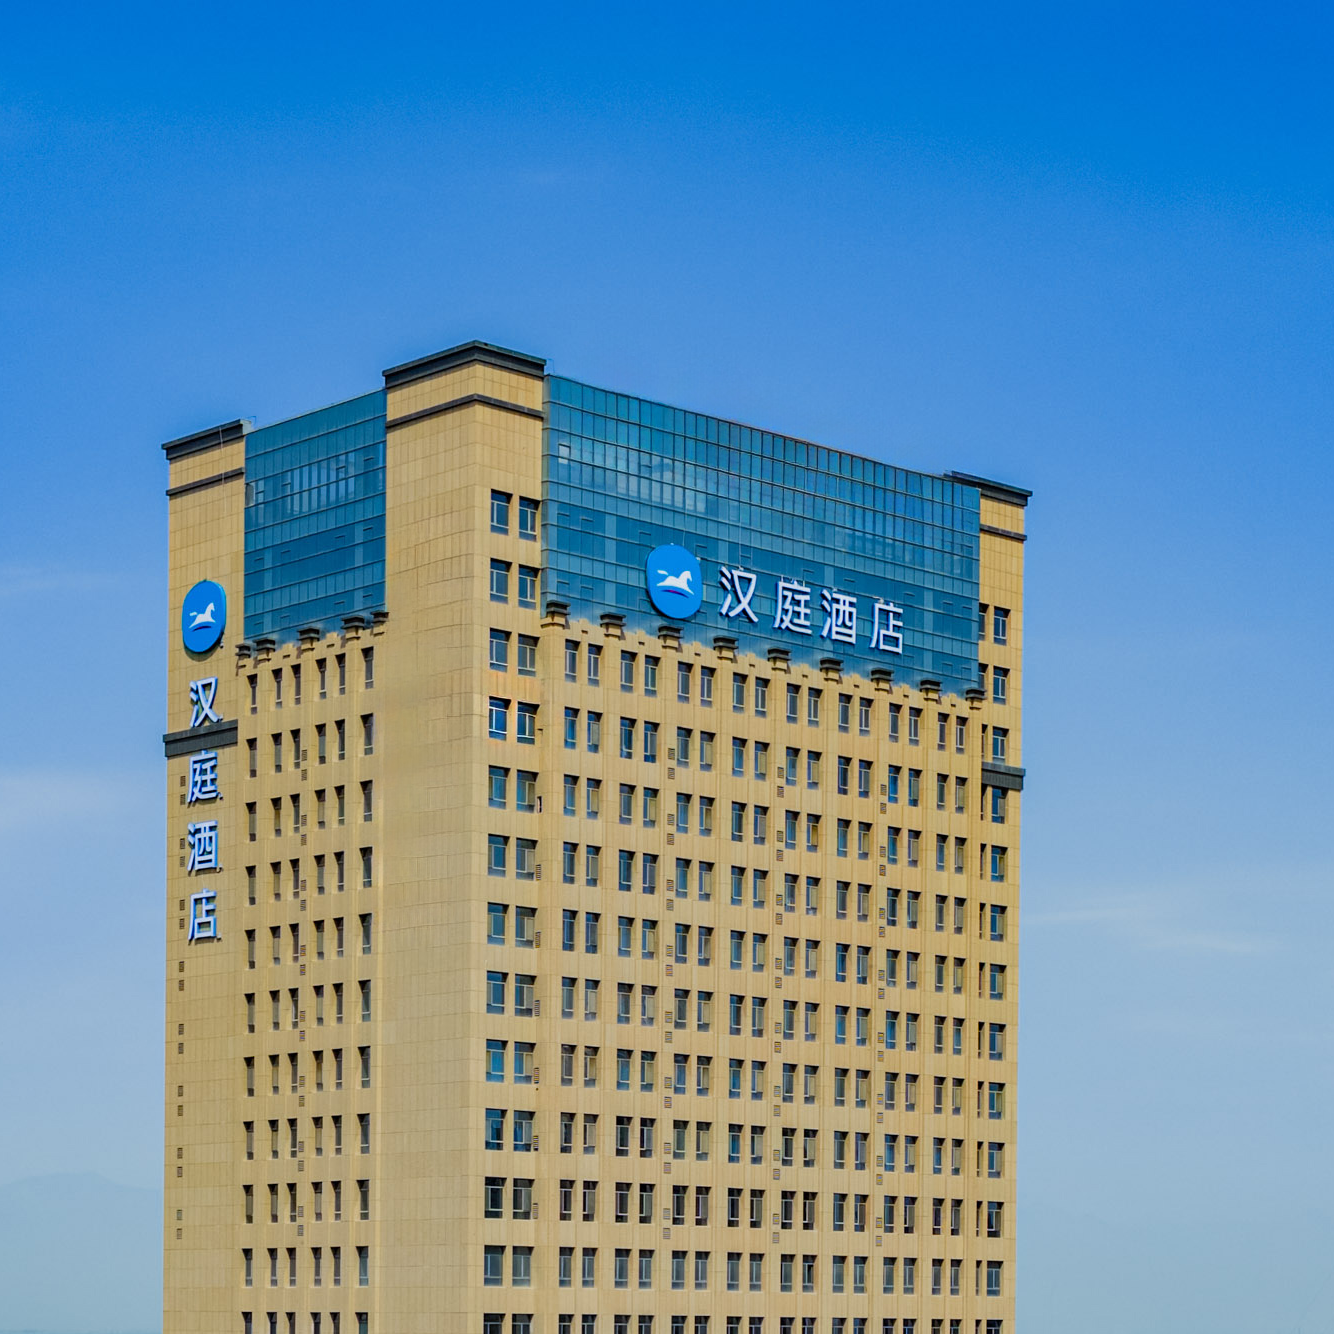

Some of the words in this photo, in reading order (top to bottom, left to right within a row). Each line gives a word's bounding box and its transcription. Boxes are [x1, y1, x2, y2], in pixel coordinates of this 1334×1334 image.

[719, 565, 904, 655] 汉庭酒店
[187, 676, 219, 942] 汉庭酒店
